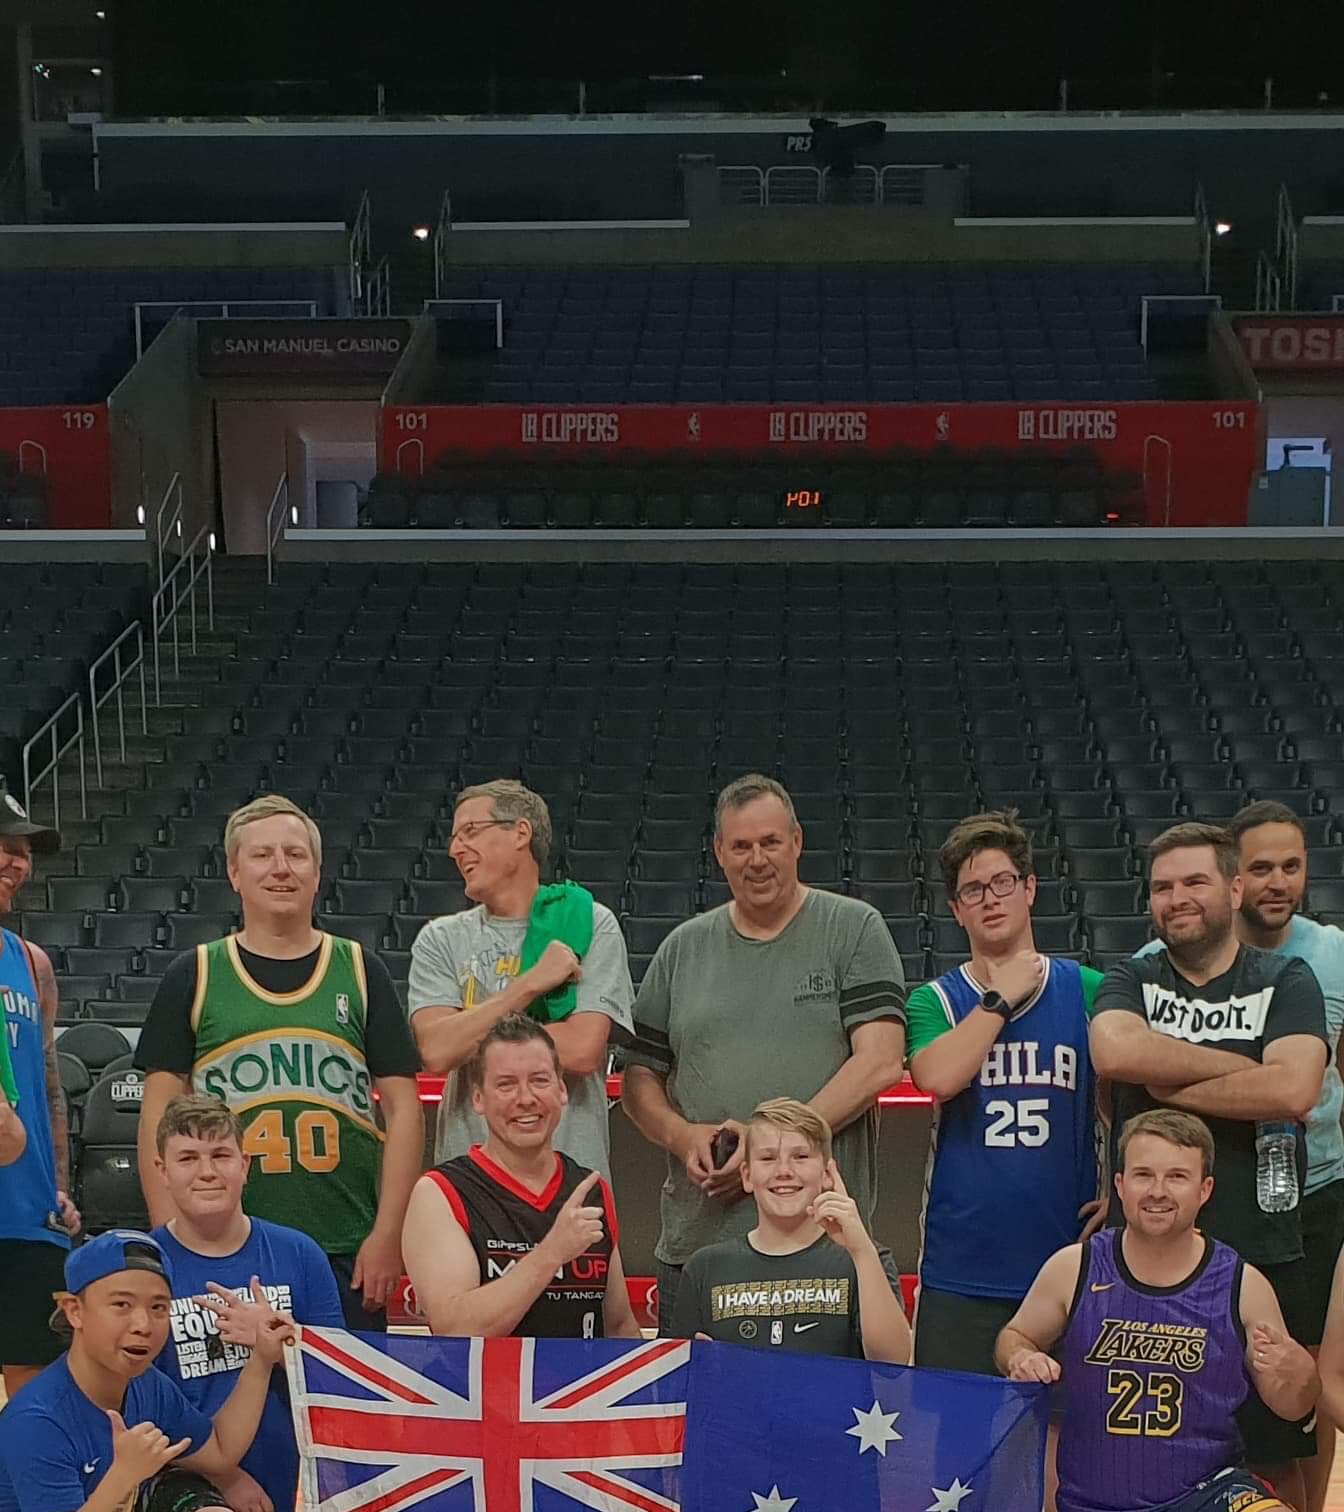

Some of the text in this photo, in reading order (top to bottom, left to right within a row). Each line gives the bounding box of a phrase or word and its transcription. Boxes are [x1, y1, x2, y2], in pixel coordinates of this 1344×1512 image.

[225, 338, 401, 352] SAN MANUEL CASINO
[62, 412, 95, 428] 119
[395, 413, 428, 430] 101
[542, 412, 619, 442] CLIPPERS
[790, 411, 867, 441] CLIPPERS
[1039, 410, 1117, 440] CLIPPERS
[1211, 411, 1246, 428] 101
[205, 1042, 369, 1112] SONICS
[968, 1041, 1077, 1091] HILA
[984, 1098, 1050, 1147] 25
[242, 1109, 341, 1174] 40
[571, 1258, 606, 1280] UP
[718, 1288, 841, 1310] I HAVE A DREAM
[1122, 1320, 1208, 1338] LOS ANGELES
[1084, 1319, 1206, 1373] LAKERS
[1106, 1369, 1186, 1438] 23
